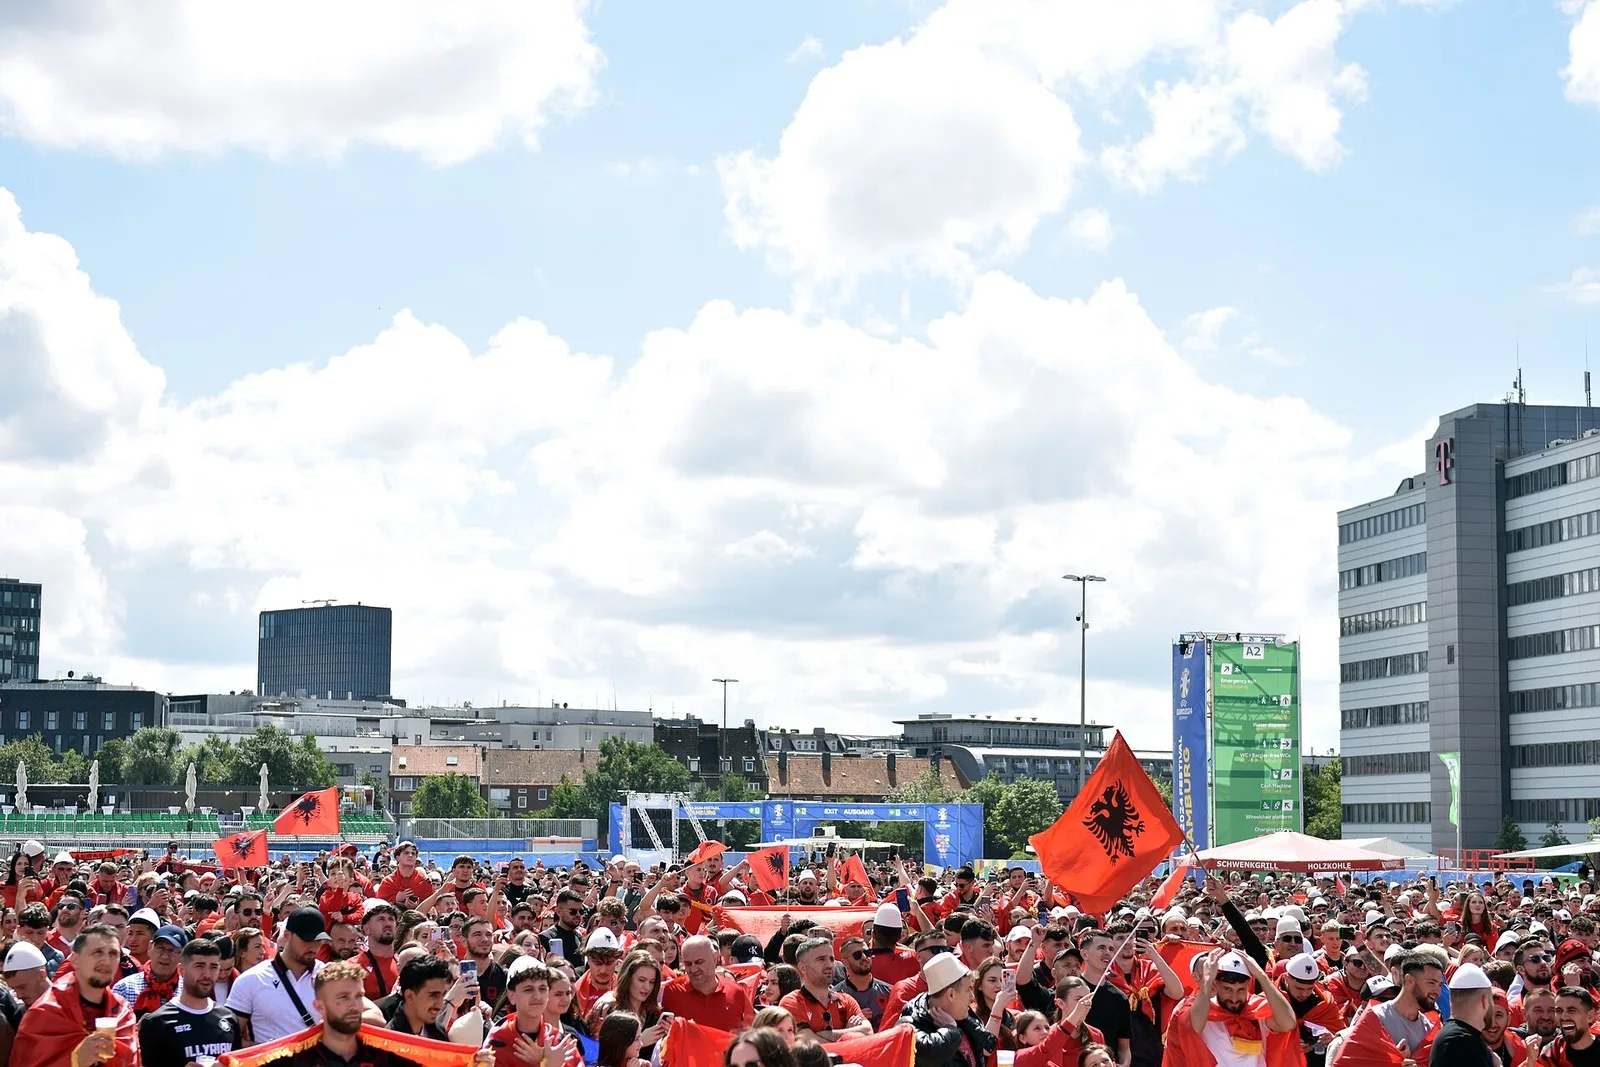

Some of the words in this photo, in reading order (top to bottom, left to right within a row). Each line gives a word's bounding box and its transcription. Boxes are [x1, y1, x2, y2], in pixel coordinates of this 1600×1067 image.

[1245, 646, 1261, 657] A2
[1220, 677, 1247, 685] Emergency
[843, 808, 875, 816] AUSGANG
[1216, 860, 1279, 870] SCHWENKGRILL
[1307, 861, 1352, 870] HOLZKOHLE
[174, 1023, 192, 1033] 1912
